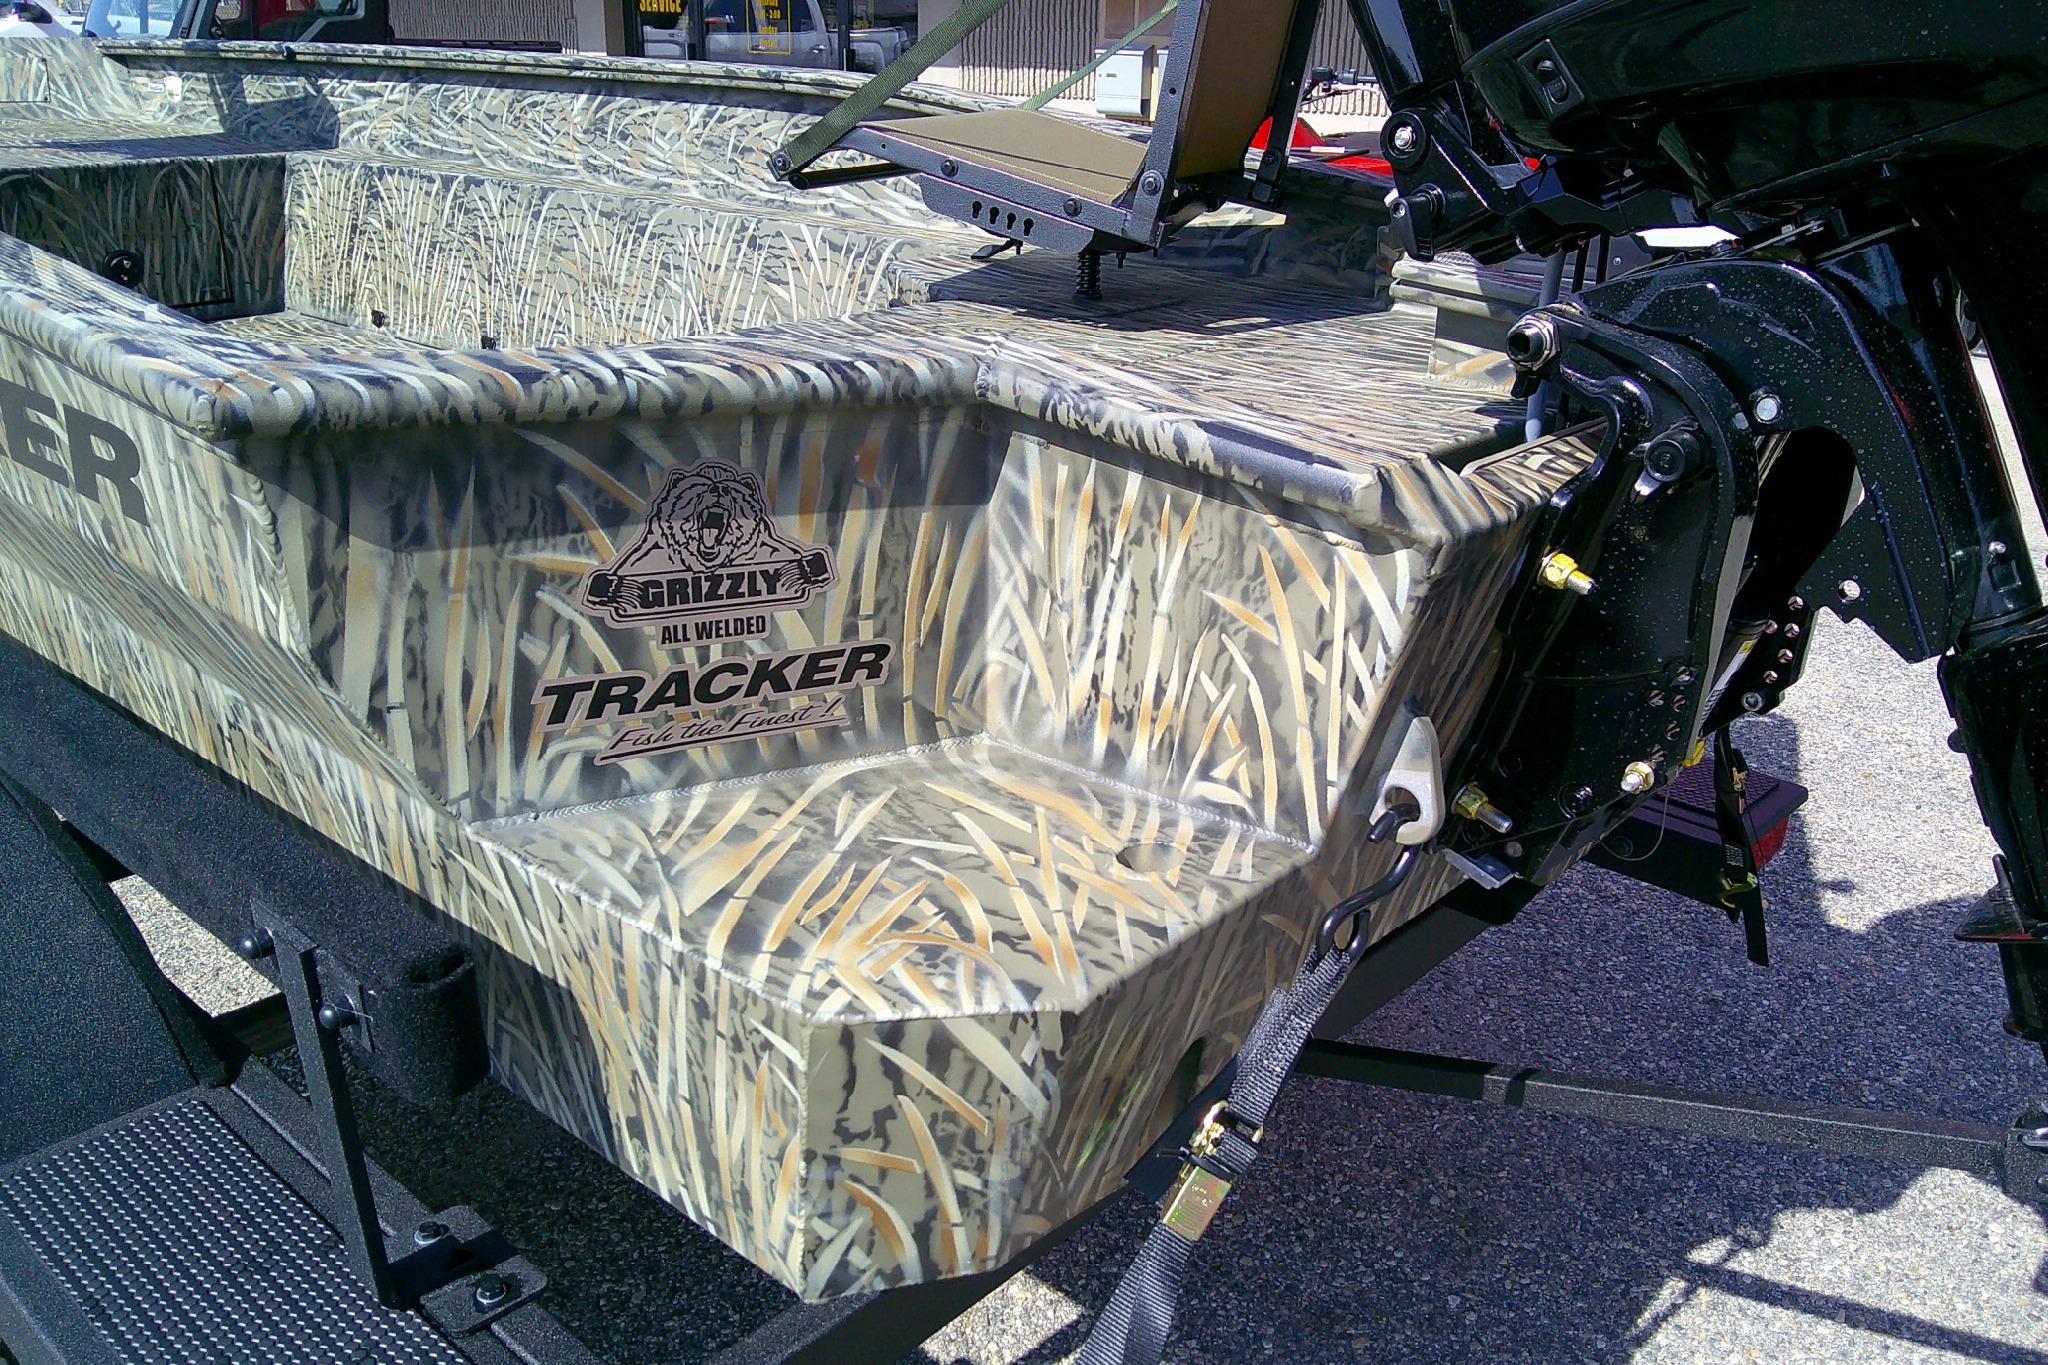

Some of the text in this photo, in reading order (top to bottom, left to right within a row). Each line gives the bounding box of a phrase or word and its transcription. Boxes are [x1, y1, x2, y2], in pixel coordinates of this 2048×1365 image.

[640, 0, 682, 12] SERVICE
[638, 568, 782, 609] GRIZZLY
[661, 615, 766, 645] ALL WELDED
[541, 643, 892, 726] TRACKER
[610, 727, 675, 750] Fish
[680, 720, 724, 739] the
